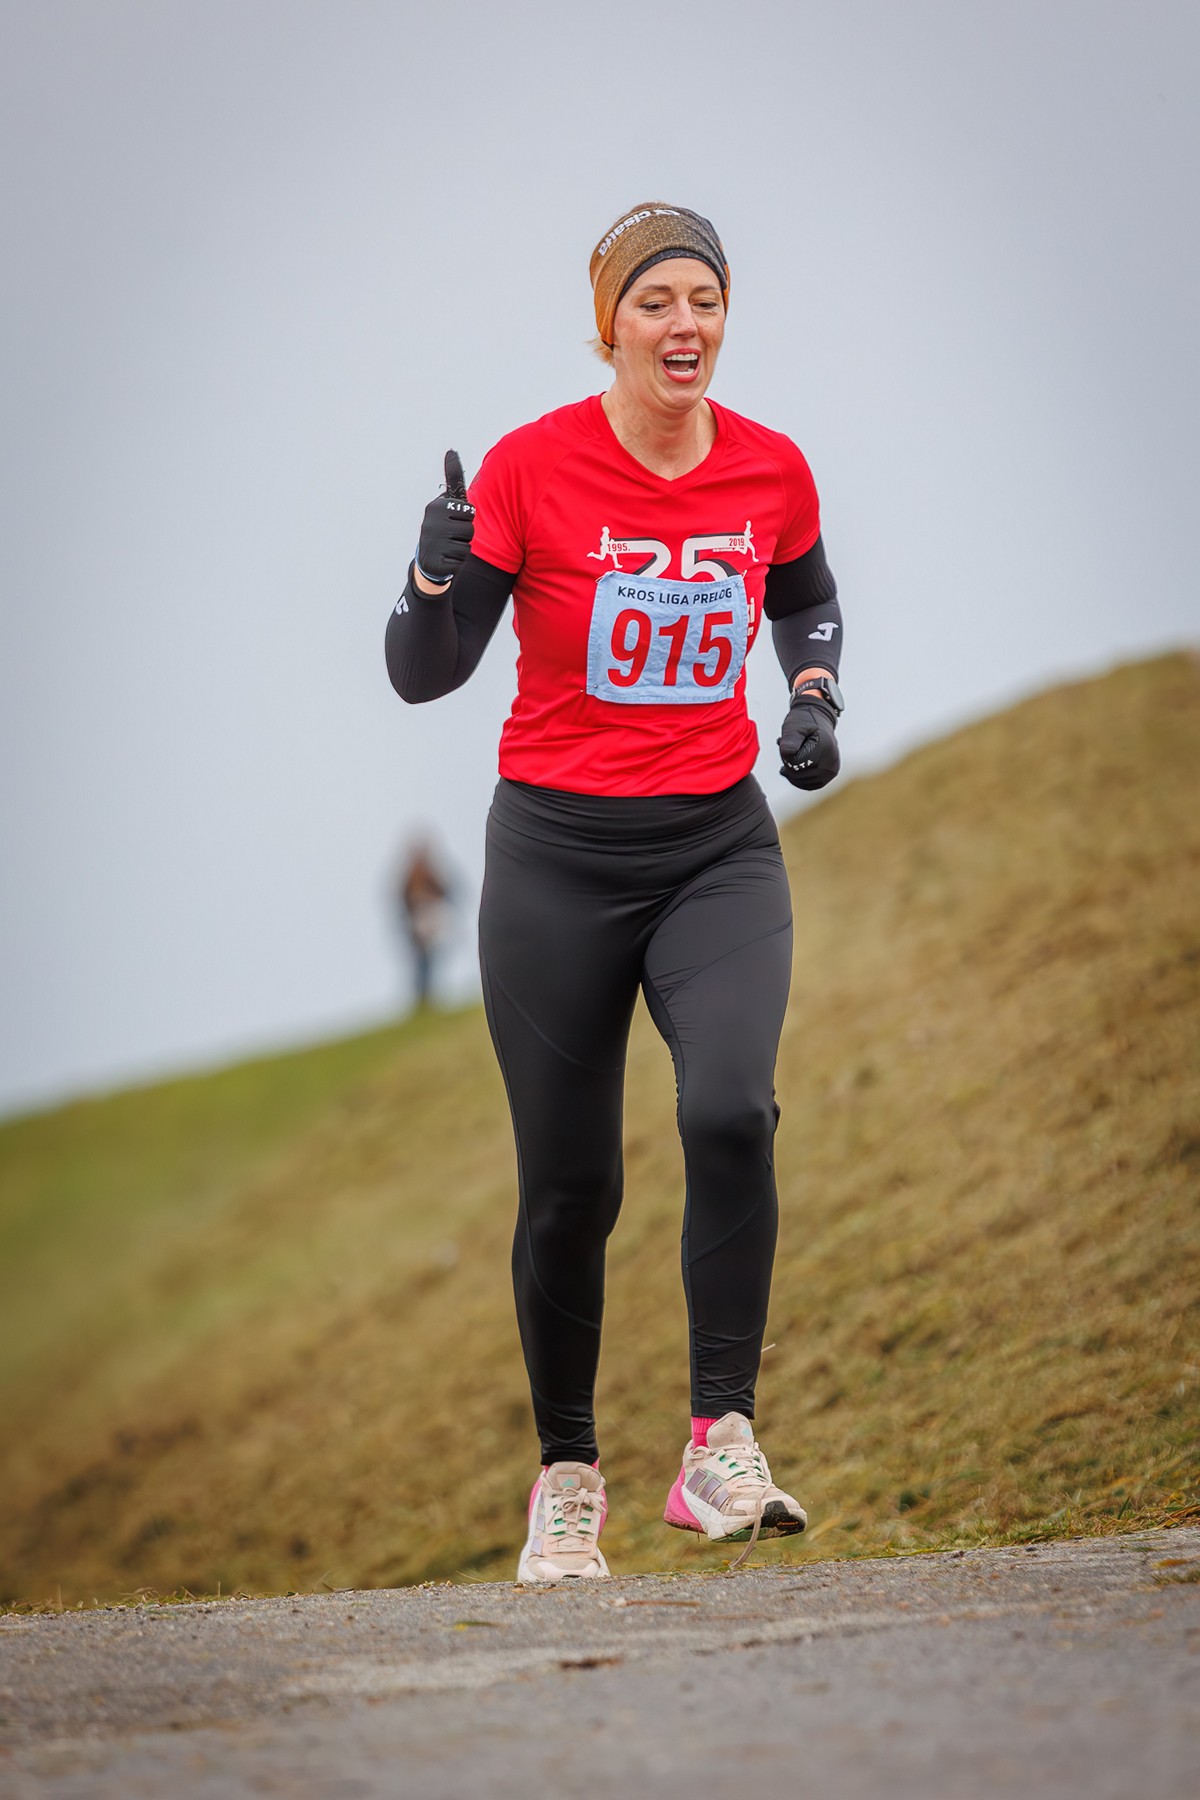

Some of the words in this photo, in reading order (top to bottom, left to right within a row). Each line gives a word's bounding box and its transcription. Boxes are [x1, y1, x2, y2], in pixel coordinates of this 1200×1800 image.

[618, 585, 655, 602] KROS
[659, 593, 690, 606] LIGA
[692, 587, 733, 606] PRELOG
[607, 608, 734, 688] 915
